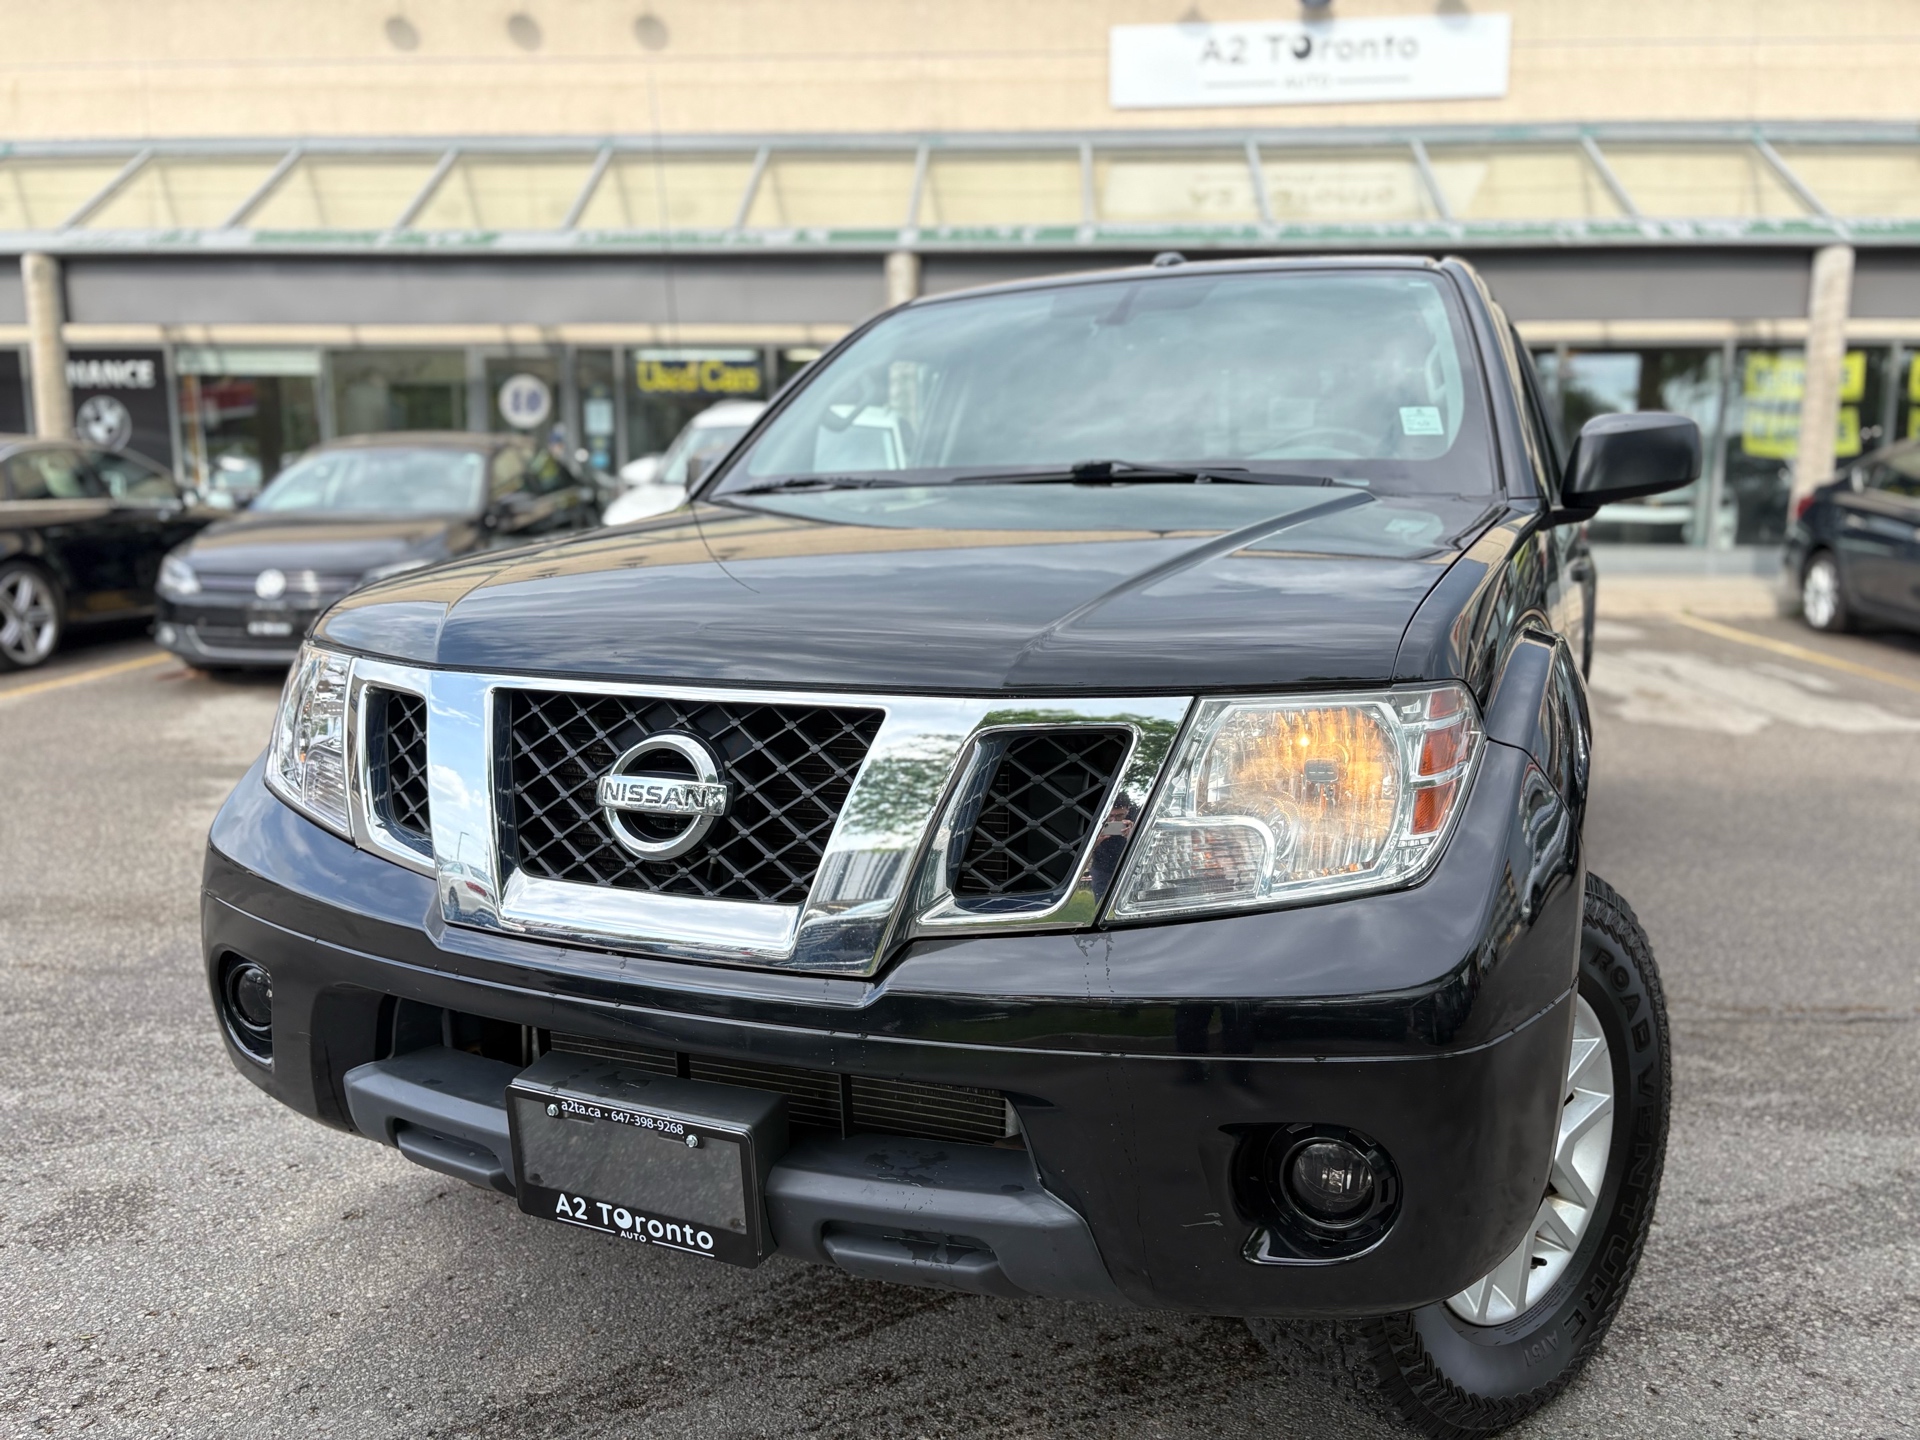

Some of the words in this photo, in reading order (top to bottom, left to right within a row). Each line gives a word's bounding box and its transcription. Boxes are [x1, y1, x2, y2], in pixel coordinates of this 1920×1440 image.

[1203, 35, 1249, 65] A2
[604, 781, 707, 808] NISSAN
[561, 1100, 601, 1118] a2ta.ca
[611, 1111, 684, 1135] 647-398-9268
[556, 1193, 588, 1220] A2
[620, 1230, 647, 1243] AUTO
